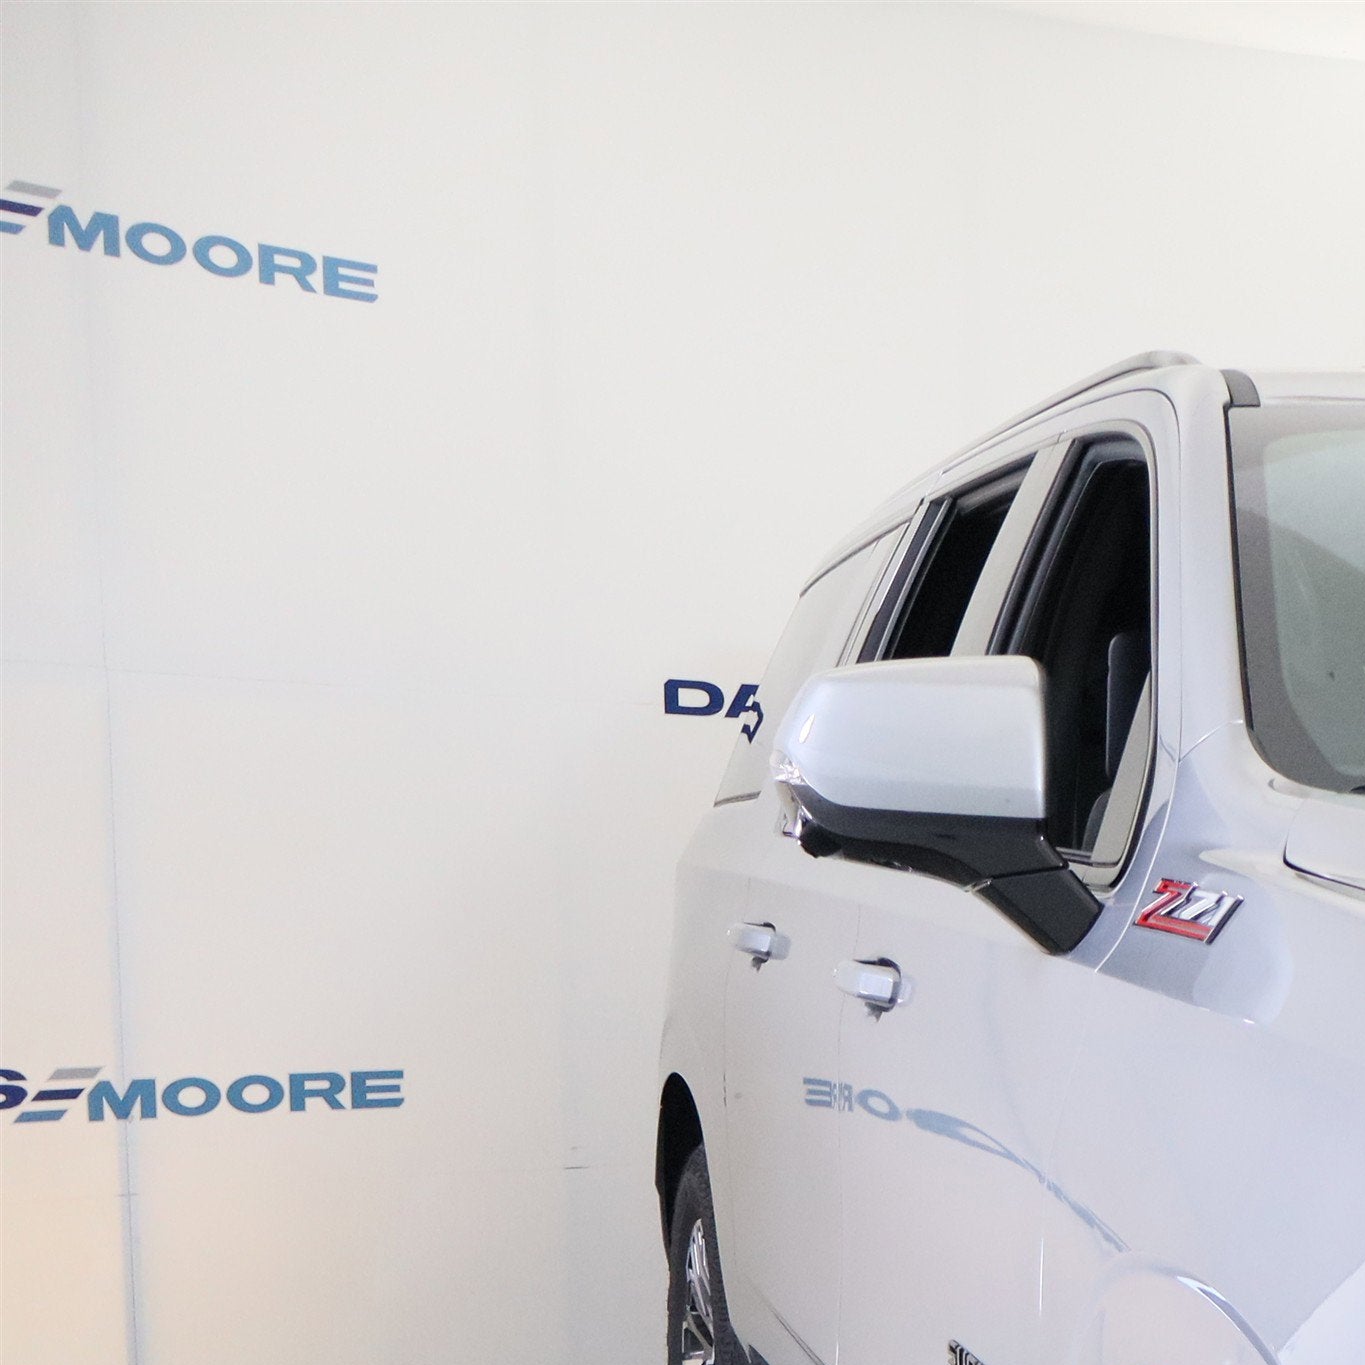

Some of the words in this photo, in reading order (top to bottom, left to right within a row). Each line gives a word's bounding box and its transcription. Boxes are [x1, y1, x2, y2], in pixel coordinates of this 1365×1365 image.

[48, 204, 378, 304] MOORE
[1134, 877, 1245, 945] Z71
[87, 1069, 405, 1122] MOORE
